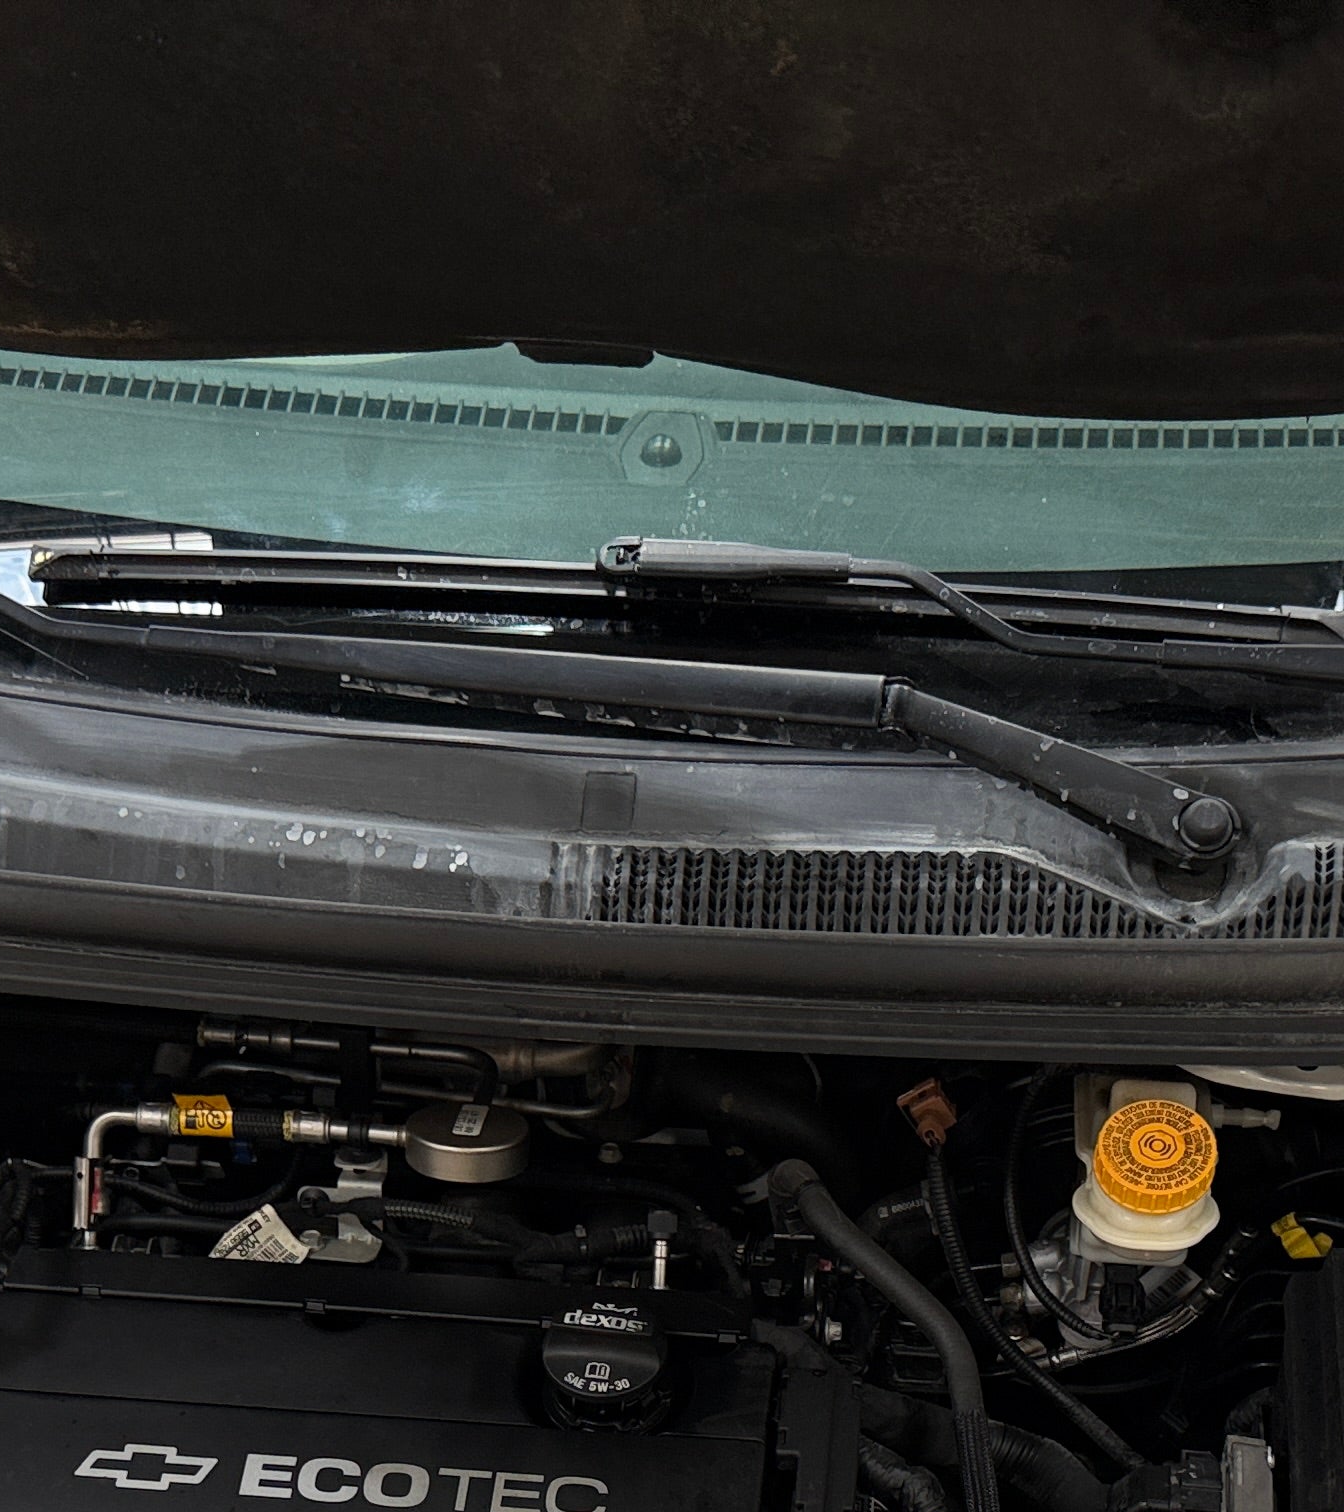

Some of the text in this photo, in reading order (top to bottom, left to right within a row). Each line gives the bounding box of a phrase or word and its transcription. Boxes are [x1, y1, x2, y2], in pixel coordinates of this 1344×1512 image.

[564, 1309, 643, 1332] dexos
[564, 1372, 630, 1392] SAE 5W-30
